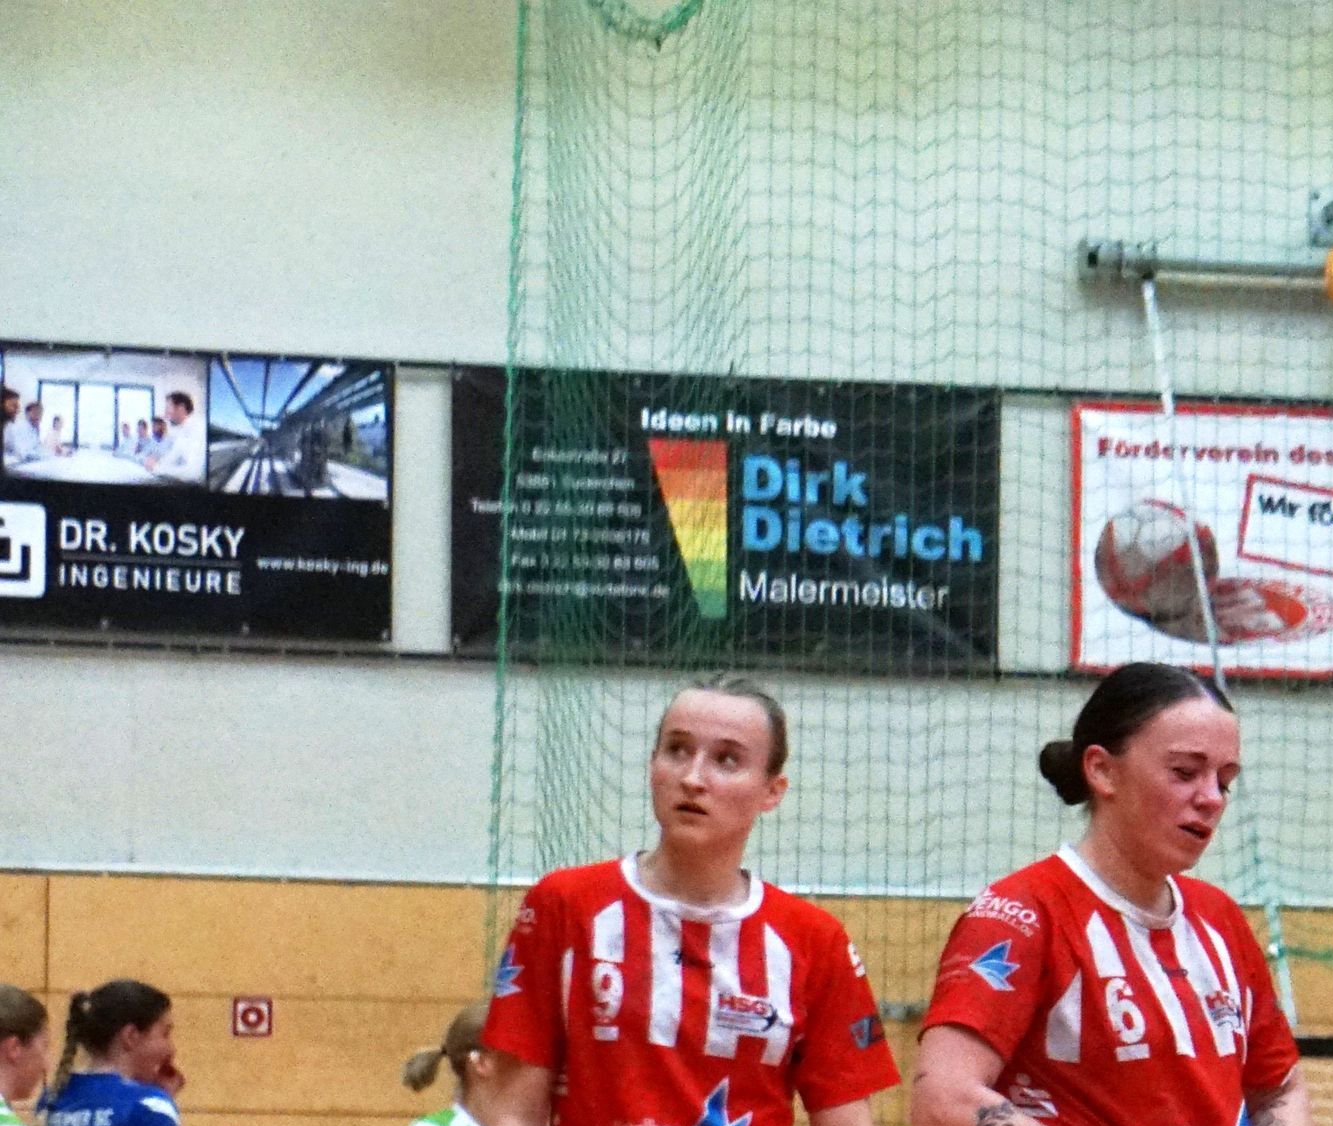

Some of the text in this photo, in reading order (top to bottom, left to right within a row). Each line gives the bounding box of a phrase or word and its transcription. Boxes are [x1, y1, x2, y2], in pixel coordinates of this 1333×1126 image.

[640, 406, 719, 433] Ideen
[759, 411, 837, 439] Farbe
[742, 454, 868, 506] Dirk
[1258, 493, 1300, 518] Wir
[58, 516, 246, 557] DR. KOSKY
[742, 506, 983, 562] Dietrich
[58, 564, 242, 595] INGENIEURE
[738, 569, 950, 610] Malermeister
[1104, 977, 1147, 1044] 6
